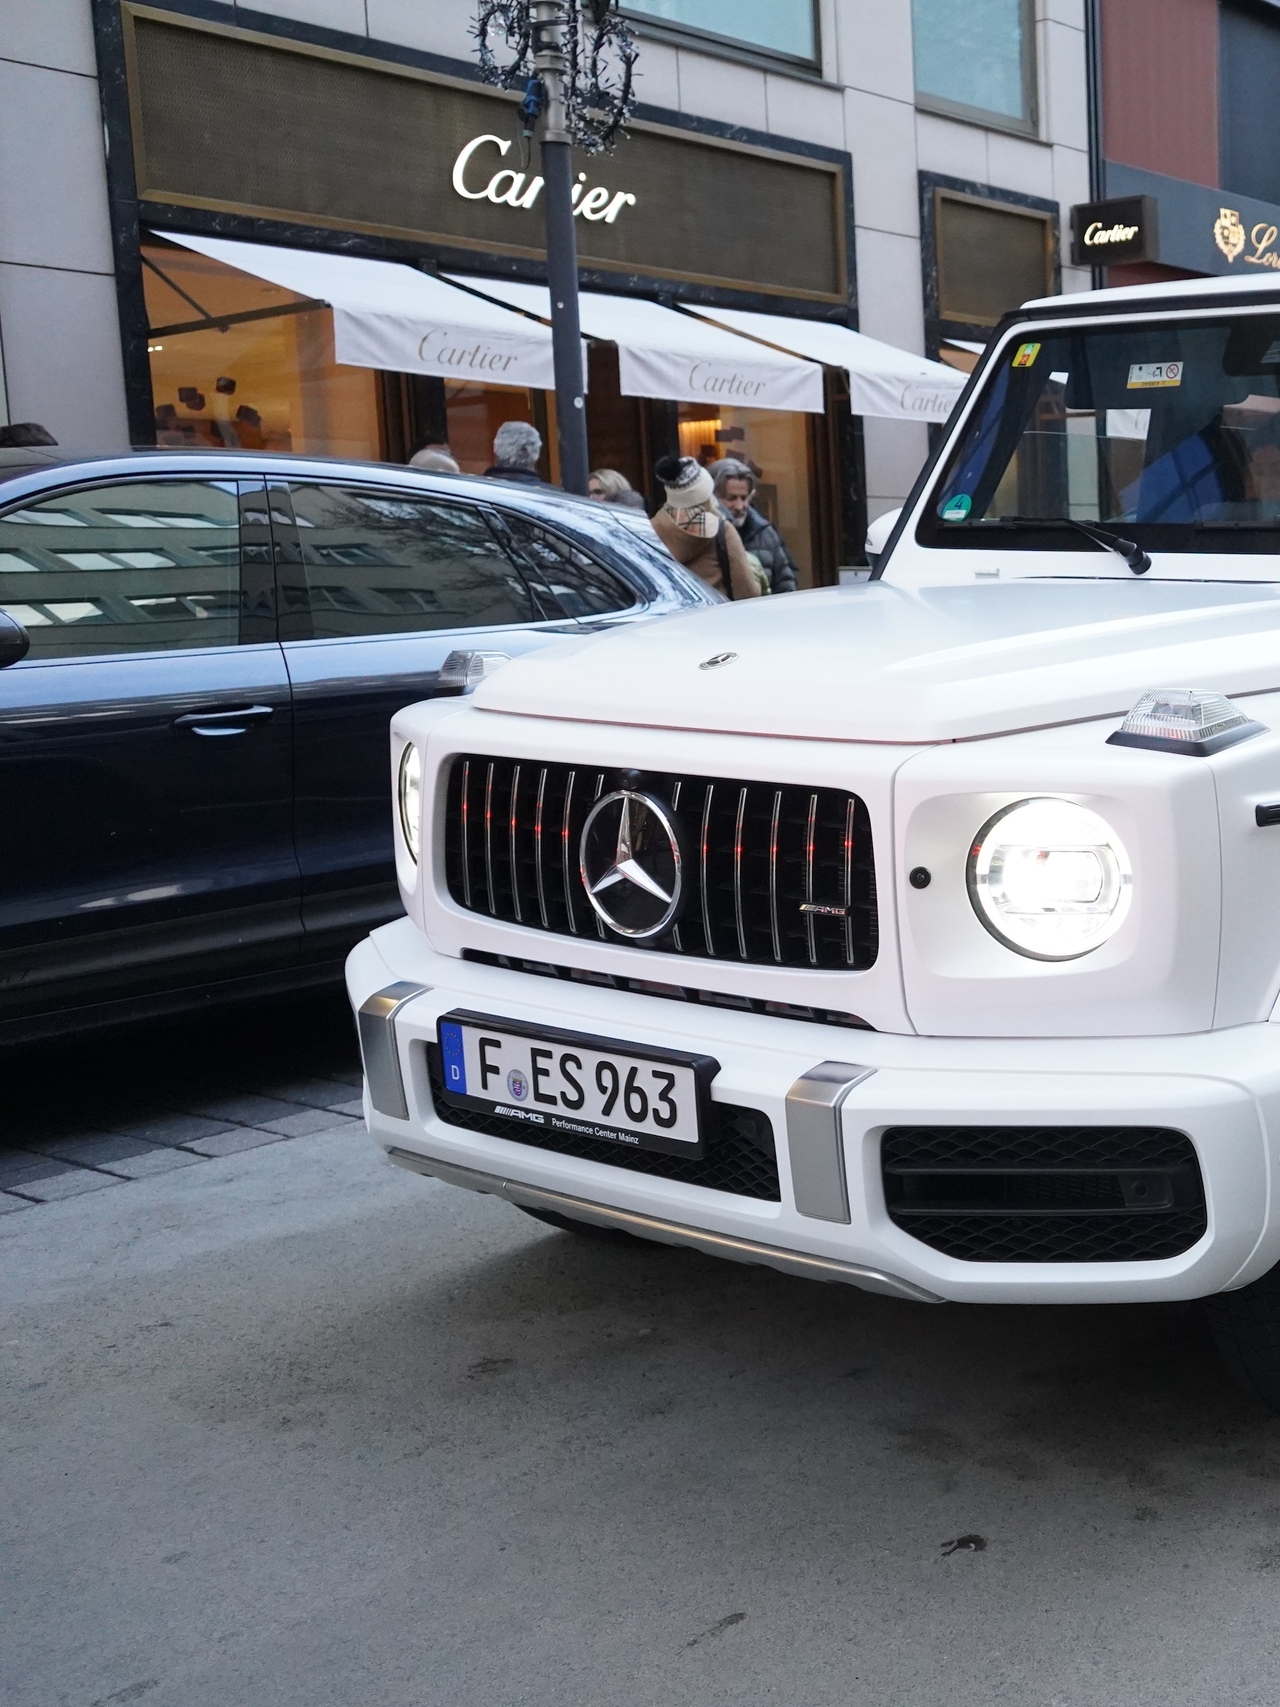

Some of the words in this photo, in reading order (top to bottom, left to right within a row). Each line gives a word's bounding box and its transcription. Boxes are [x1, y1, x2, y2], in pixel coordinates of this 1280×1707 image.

[452, 134, 636, 223] Carier
[1084, 223, 1138, 246] Cartier
[418, 328, 518, 373] Cartier
[689, 362, 766, 397] Cartier
[900, 383, 953, 414] Cartie
[954, 495, 964, 510] 4
[811, 905, 846, 915] AMG
[451, 1065, 460, 1080] D
[479, 1037, 501, 1090] F
[508, 1109, 545, 1124] AMG
[552, 1118, 593, 1135] Performance
[594, 1127, 617, 1140] Center
[618, 1132, 639, 1145] Mainz
